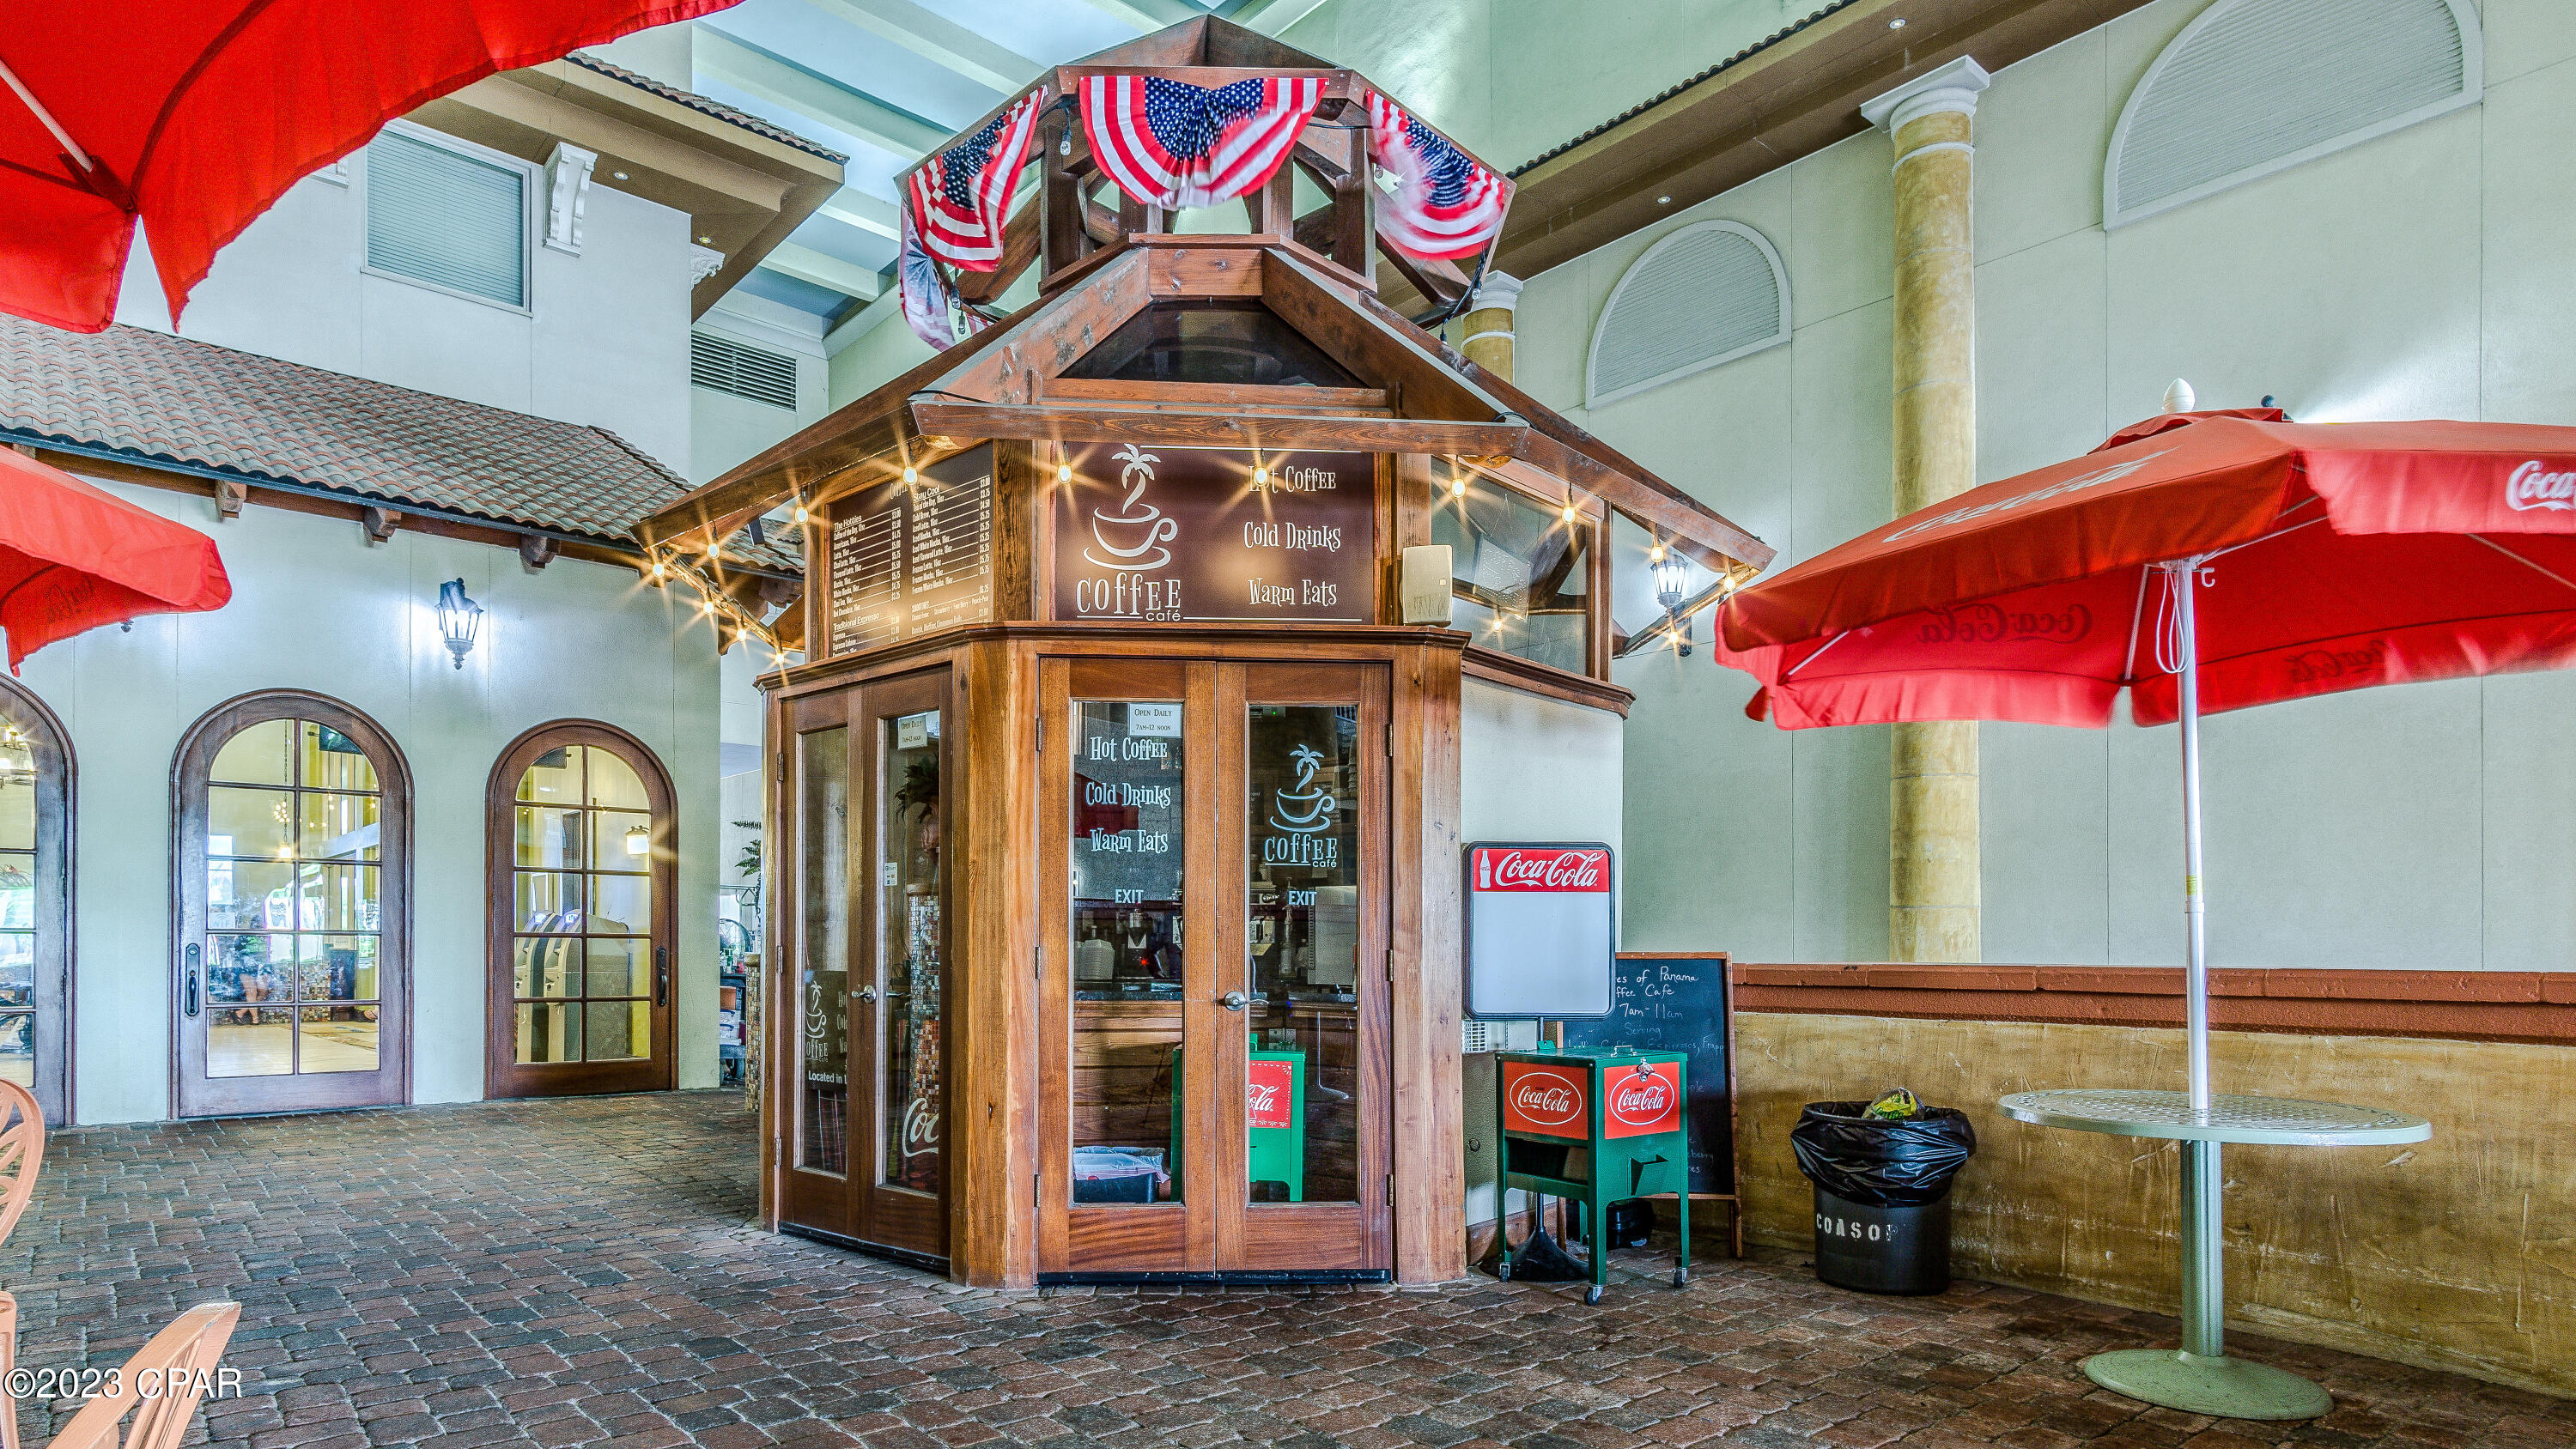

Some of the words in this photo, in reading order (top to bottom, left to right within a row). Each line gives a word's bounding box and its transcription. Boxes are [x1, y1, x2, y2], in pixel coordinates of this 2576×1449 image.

[914, 492, 927, 501] Stay
[927, 485, 940, 496] Cool
[834, 522, 843, 530] The
[1244, 521, 1279, 549] Cold
[1302, 579, 1337, 607] Eats
[1145, 609, 1181, 621] café
[1090, 736, 1117, 762] Hot
[1085, 781, 1118, 806] Cold
[1137, 829, 1168, 854] Eats
[1312, 859, 1337, 868] café
[1495, 852, 1605, 888] Coca-Cola
[1115, 888, 1145, 904] EXIT
[1288, 890, 1317, 906] EXIT
[1636, 969, 1649, 987] of
[1660, 966, 1699, 983] Panama
[1644, 983, 1674, 999] Cafe
[808, 1070, 834, 1082] Located
[836, 1073, 842, 1083] in
[1518, 1085, 1572, 1113] Coca-Cola
[1617, 1085, 1667, 1113] Coca-Cola
